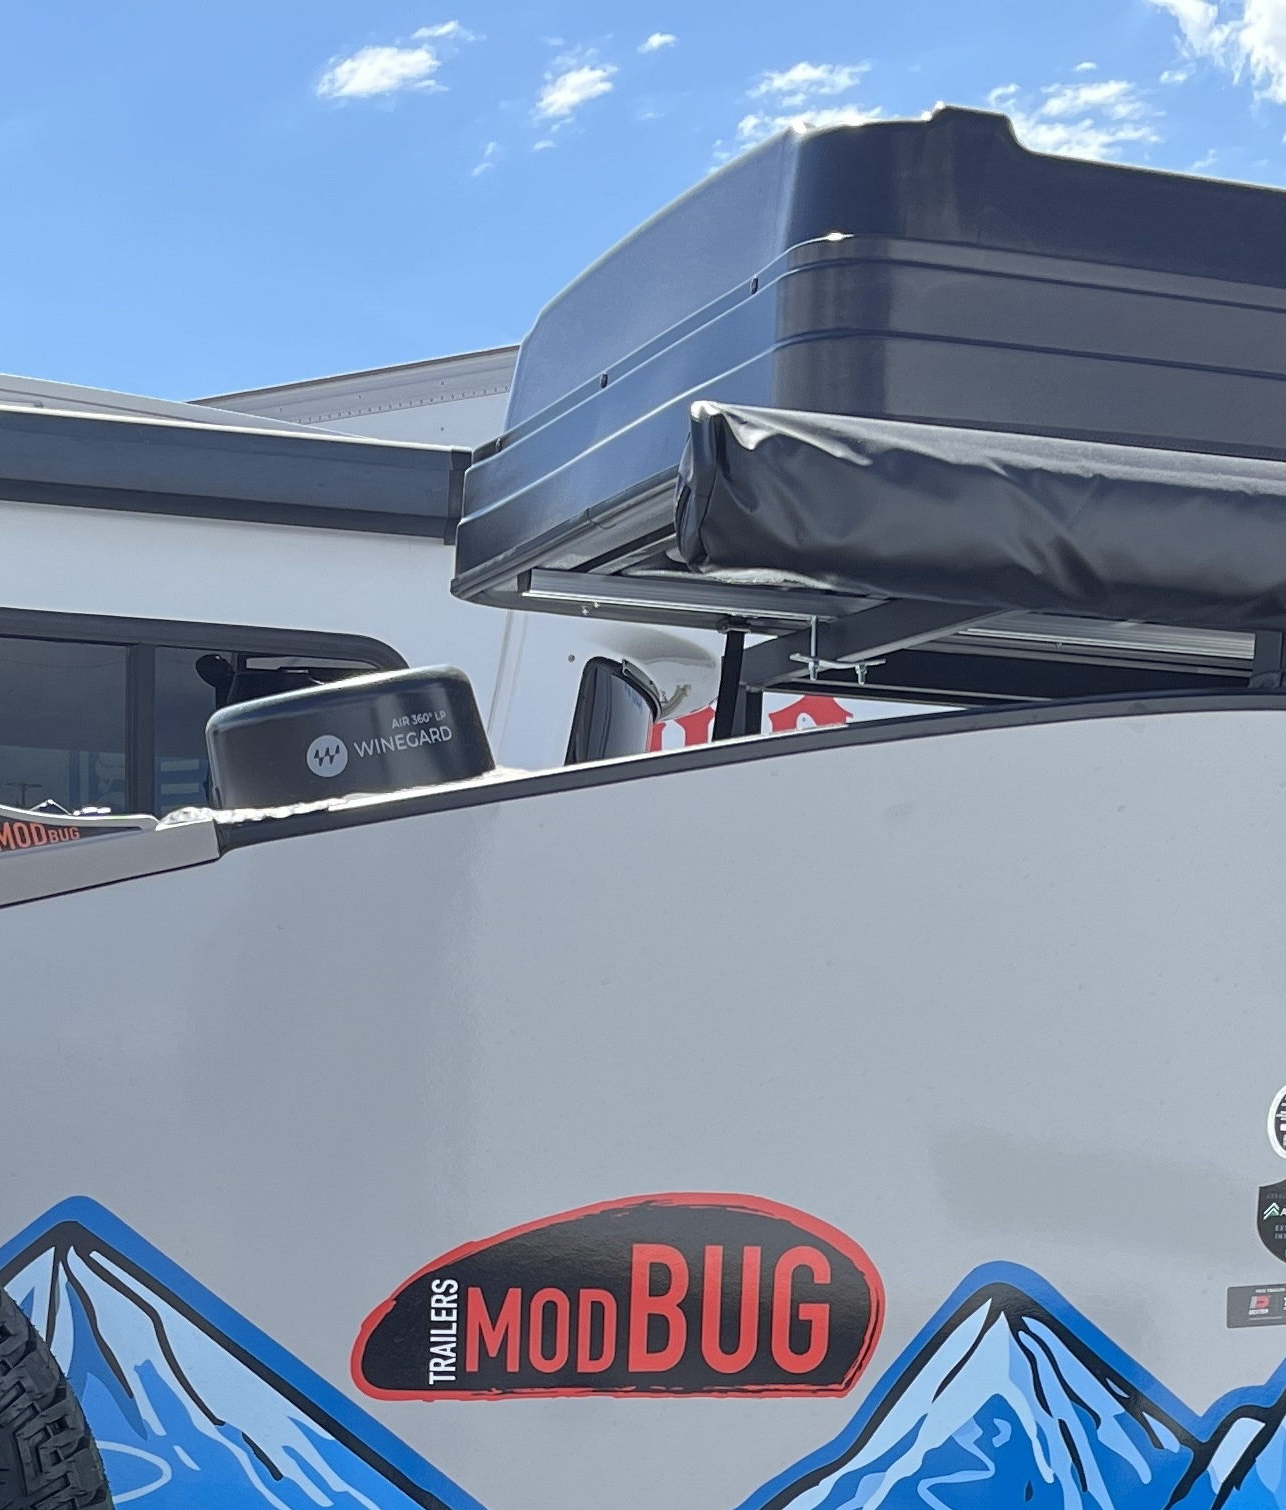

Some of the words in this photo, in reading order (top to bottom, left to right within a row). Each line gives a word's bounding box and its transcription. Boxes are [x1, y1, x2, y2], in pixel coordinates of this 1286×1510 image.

[391, 716, 410, 729] AIR
[434, 710, 446, 722] LP
[353, 726, 452, 758] WINEGARD
[429, 1278, 458, 1385] TRAILERS
